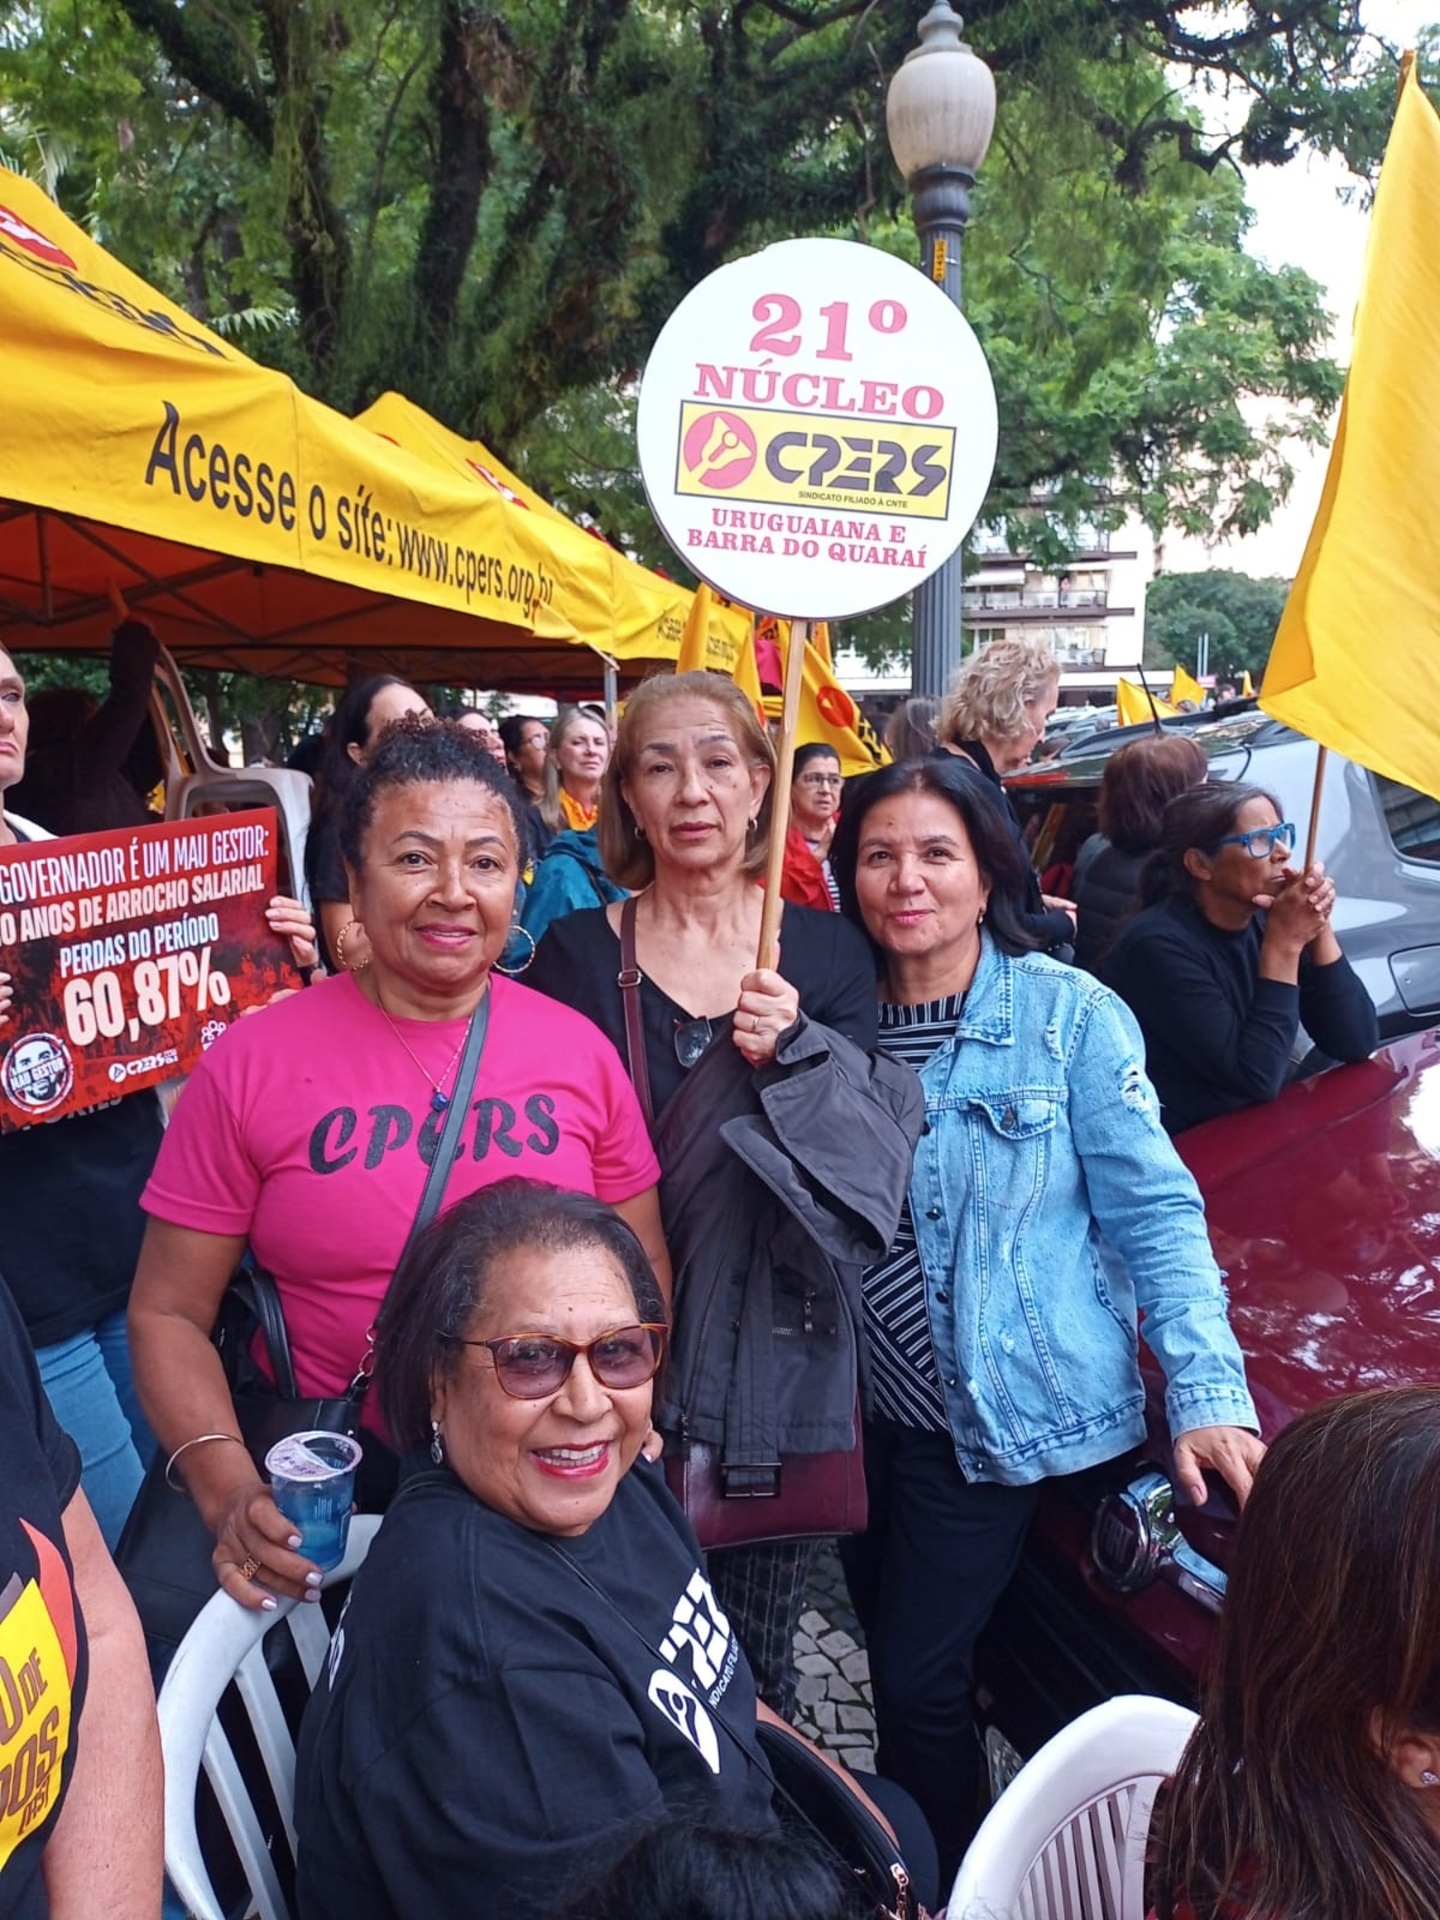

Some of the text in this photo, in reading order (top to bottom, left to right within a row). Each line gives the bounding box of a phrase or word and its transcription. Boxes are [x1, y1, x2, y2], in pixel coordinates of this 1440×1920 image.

[693, 358, 944, 420] NÚCLEO
[145, 400, 296, 531] Acesse
[309, 484, 326, 540] o
[765, 431, 947, 497] CPERS
[712, 508, 906, 543] URUGUAIANA E
[798, 490, 842, 502] SINDICATO
[843, 495, 877, 506] FILIADO
[886, 499, 908, 509] CNTE
[687, 528, 927, 568] BARRA DO QUARAÍ
[0, 825, 269, 905] GOVERNADOR É UM MAU GESTOR:
[20, 901, 76, 942] ANOS
[78, 895, 104, 930] DE
[106, 878, 189, 924] ARROCHO
[192, 863, 265, 904] SALARIAL
[60, 911, 219, 979] PERDAS DO PERÍODO
[63, 946, 231, 1046] 60,87%
[17, 1646, 49, 1716] DE
